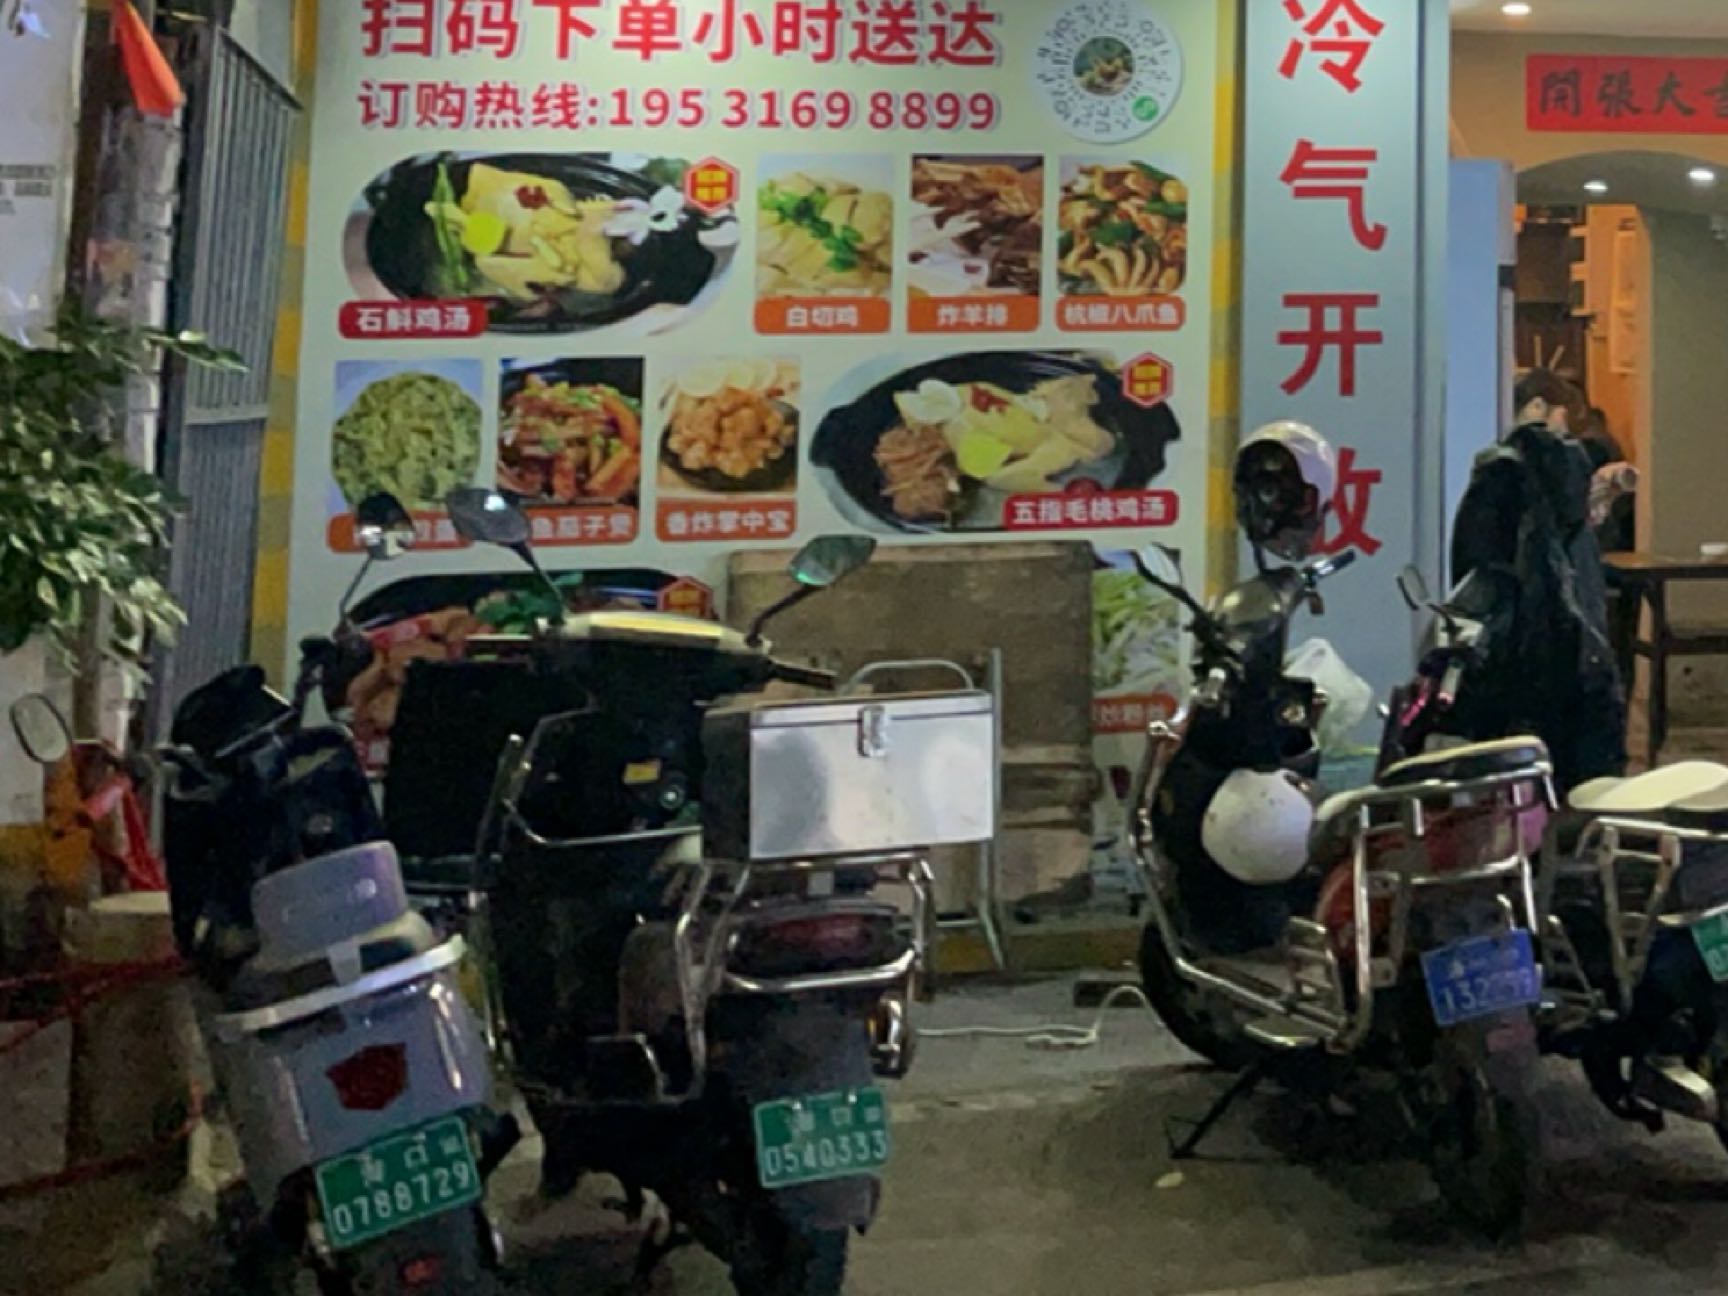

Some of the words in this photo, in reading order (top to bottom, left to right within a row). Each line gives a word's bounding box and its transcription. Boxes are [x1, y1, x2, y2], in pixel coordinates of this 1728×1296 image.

[357, 304, 471, 333] 石斛鸡汤
[332, 1160, 471, 1234] 0788729
